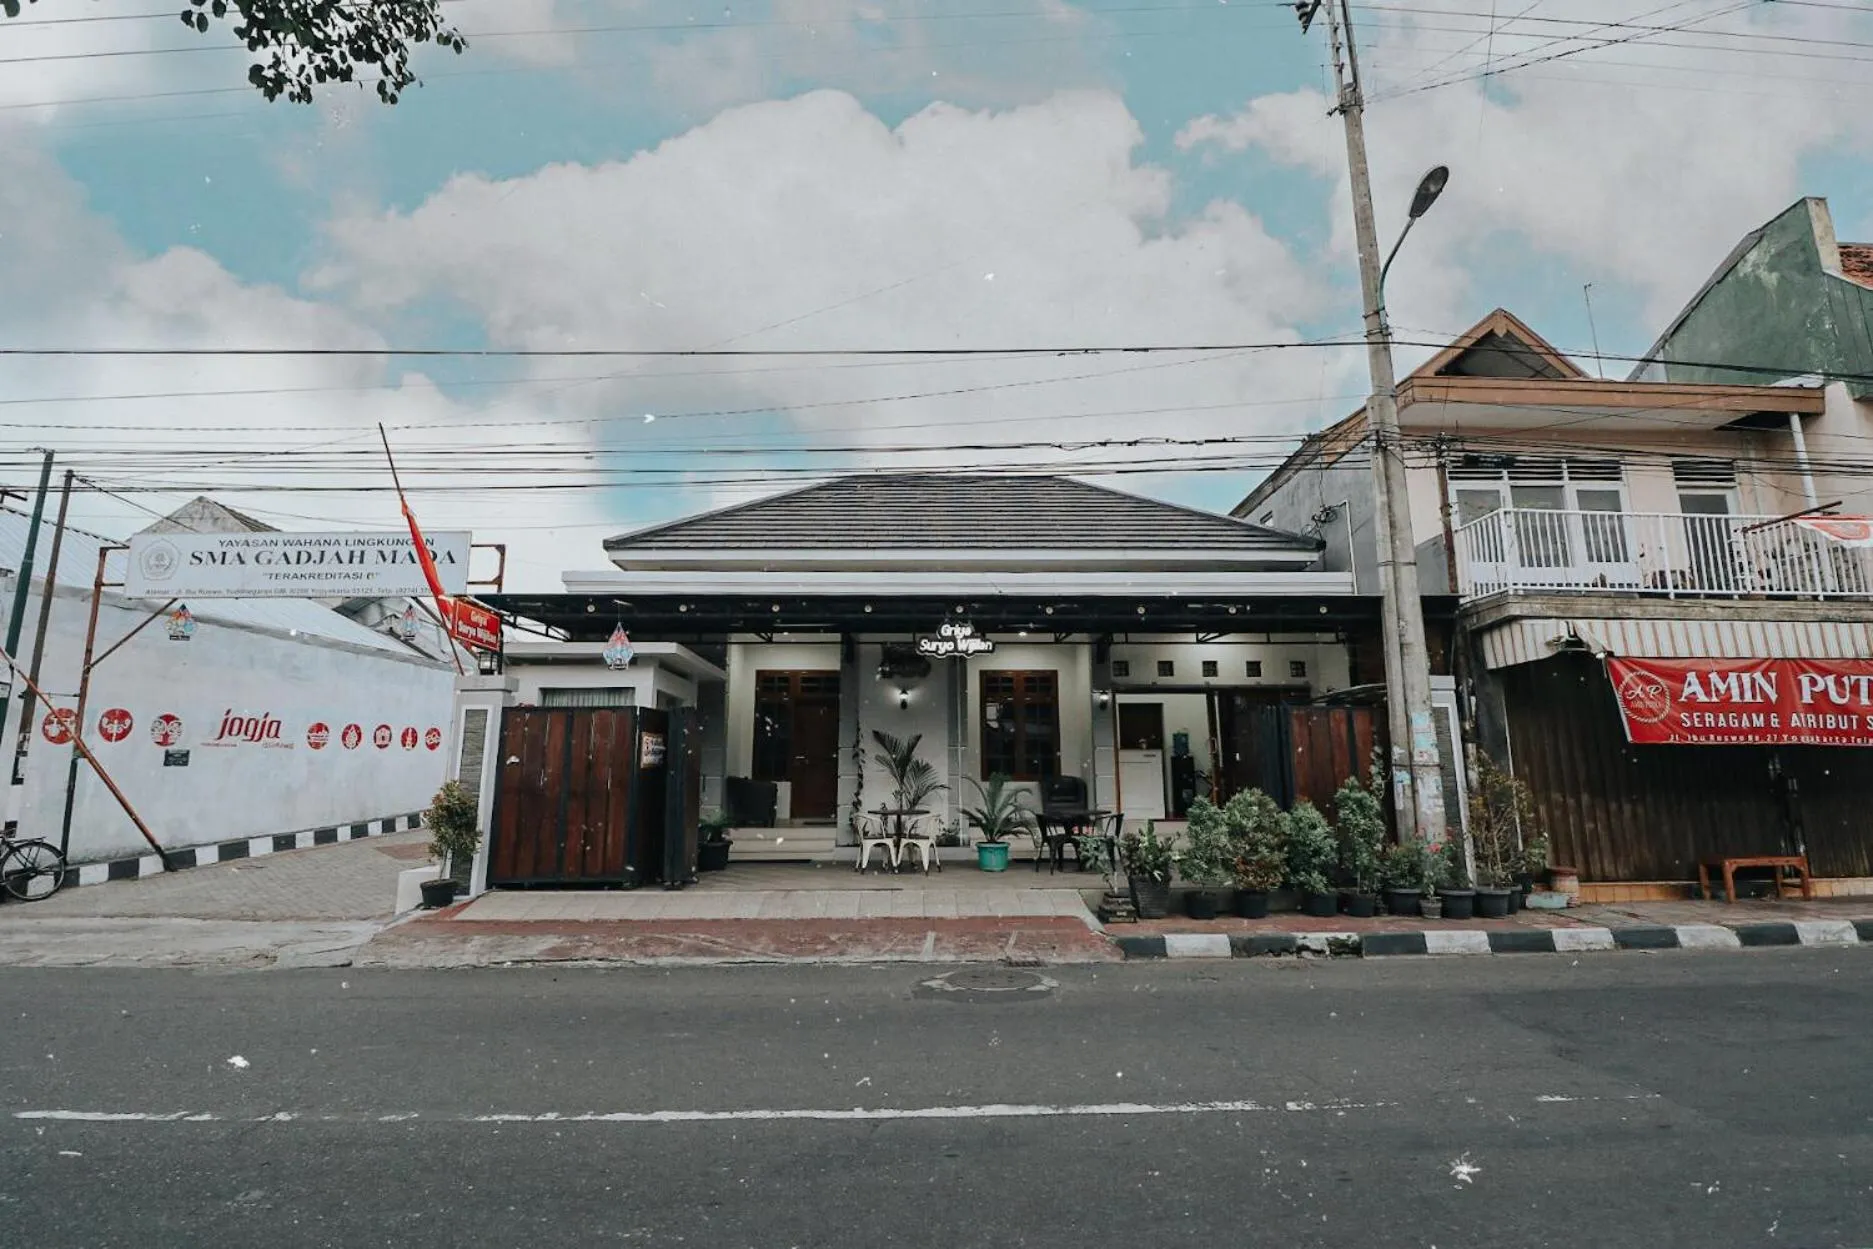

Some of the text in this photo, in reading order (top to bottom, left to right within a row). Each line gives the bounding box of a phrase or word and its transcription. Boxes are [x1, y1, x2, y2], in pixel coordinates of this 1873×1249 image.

[219, 538, 435, 548] YAYASAN WAHANA LINGKUNGN
[189, 551, 247, 566] SMA
[254, 550, 366, 566] GADJAH
[1678, 671, 1778, 704] AMIN
[215, 708, 282, 742] jogja
[1680, 712, 1765, 728] SERAGAM
[1770, 712, 1780, 728] &
